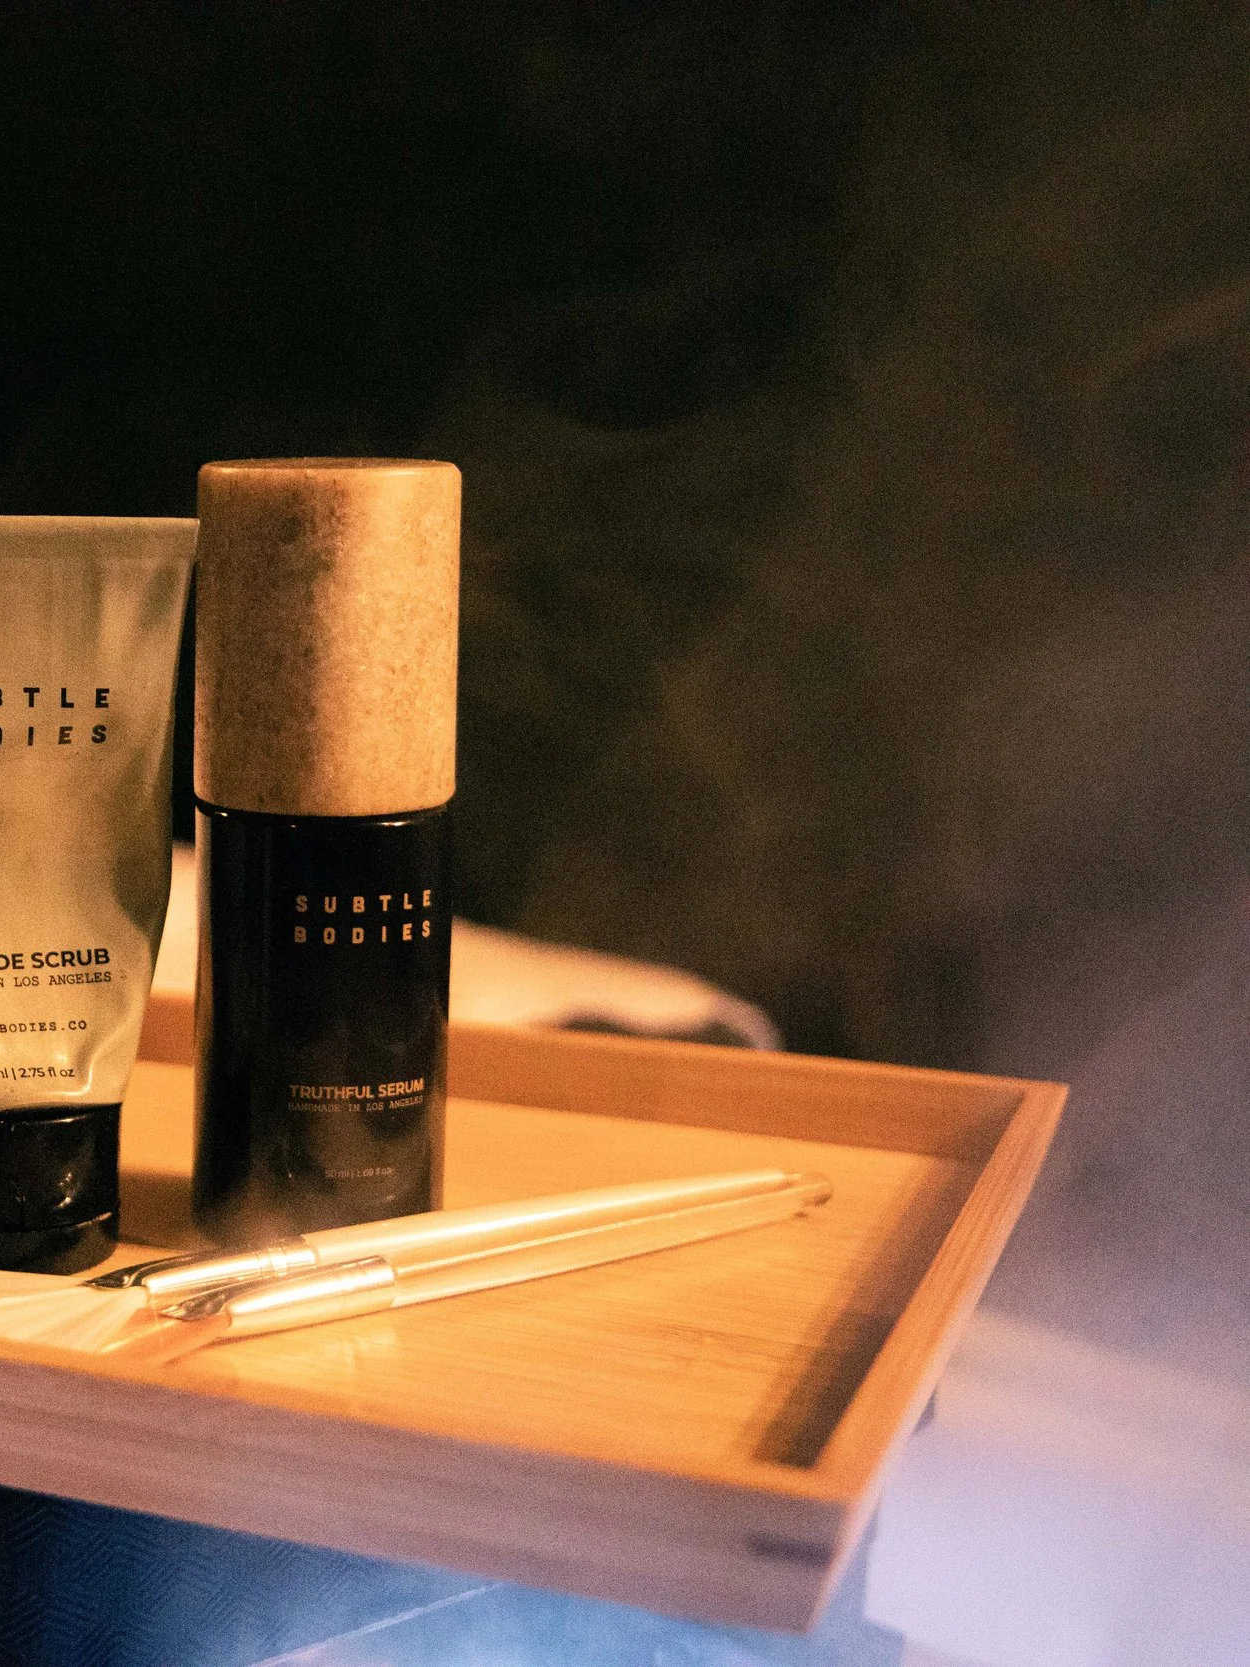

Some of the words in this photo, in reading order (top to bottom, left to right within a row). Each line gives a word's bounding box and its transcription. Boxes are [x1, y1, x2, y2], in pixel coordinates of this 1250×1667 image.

[295, 889, 432, 913] SUBTLE
[294, 919, 431, 945] BODIES
[31, 948, 111, 969] SCRUB
[14, 976, 40, 987] LOS
[48, 971, 112, 986] ANGELES
[59, 1068, 75, 1078] oz
[289, 1084, 375, 1100] TRUTHFUL
[378, 1077, 425, 1097] SERUM
[366, 1101, 384, 1112] LOS
